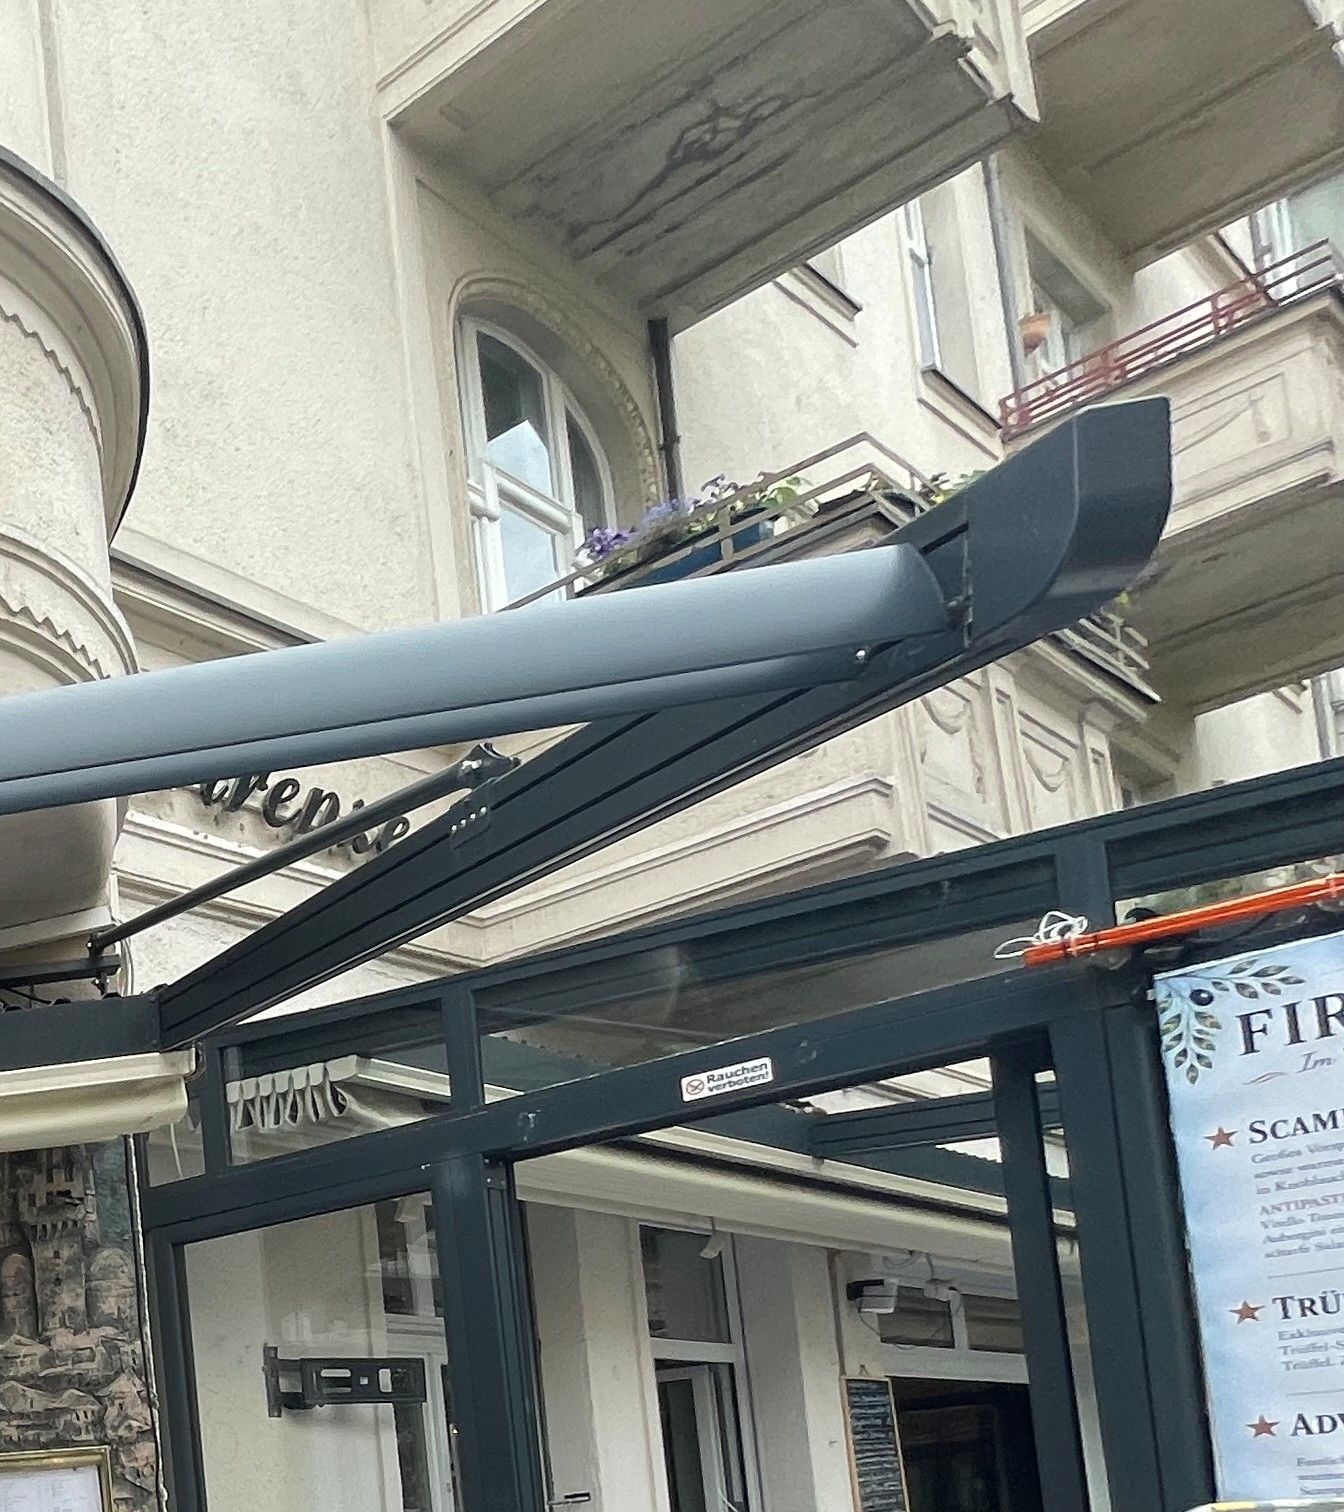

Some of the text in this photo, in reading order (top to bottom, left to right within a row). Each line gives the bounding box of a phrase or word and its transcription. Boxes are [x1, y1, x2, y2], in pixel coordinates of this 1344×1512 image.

[707, 1062, 768, 1084] Rauchen
[708, 1071, 770, 1093] verboten!
[1249, 1108, 1344, 1144] SCAM
[1272, 1290, 1344, 1319] TRÜ
